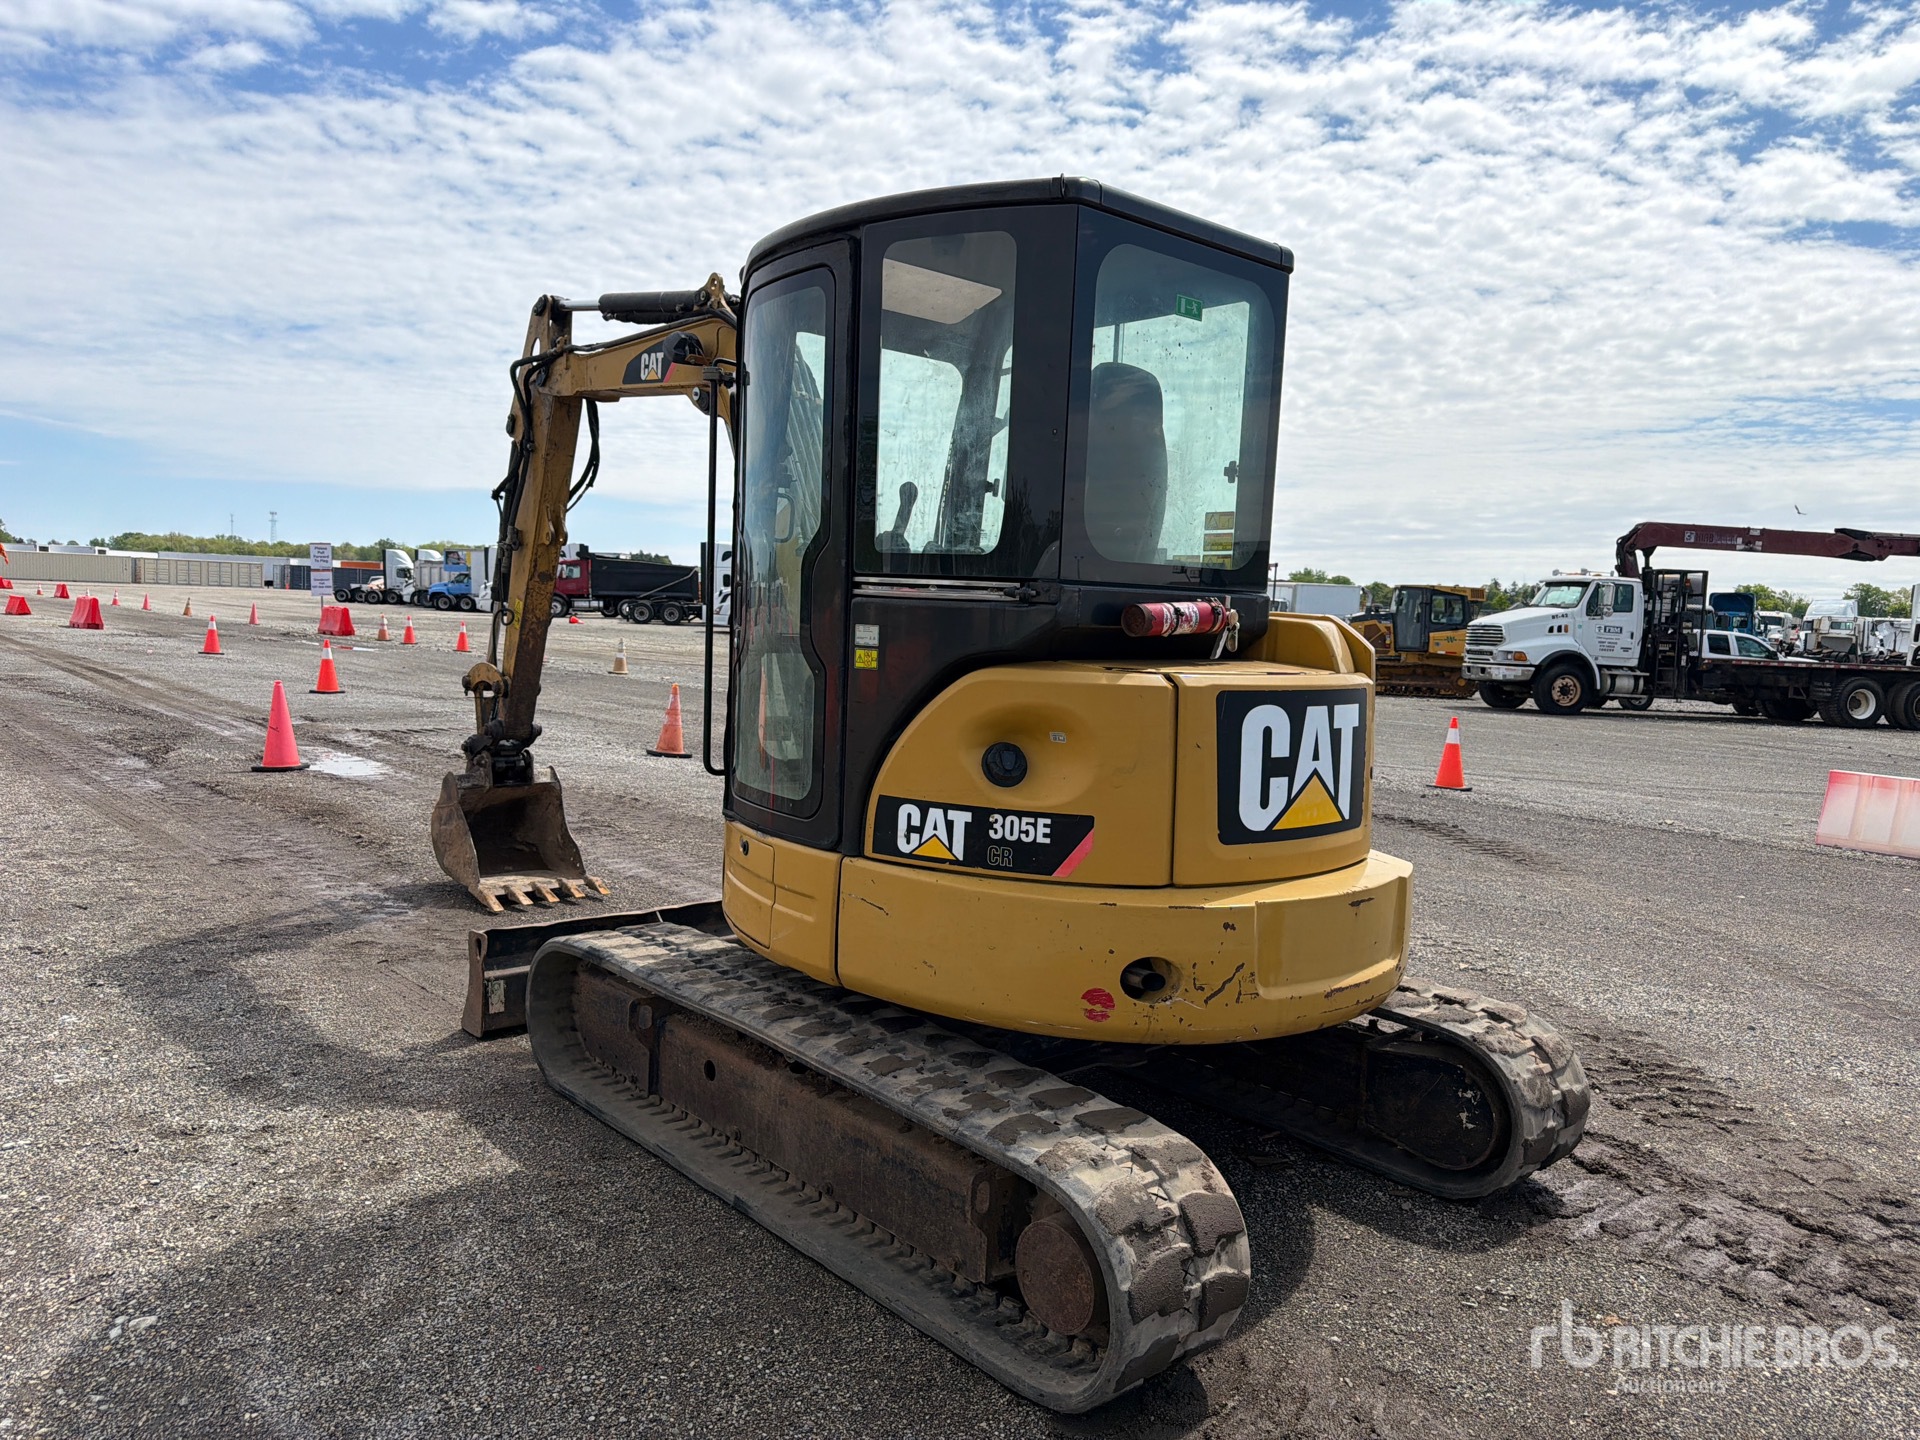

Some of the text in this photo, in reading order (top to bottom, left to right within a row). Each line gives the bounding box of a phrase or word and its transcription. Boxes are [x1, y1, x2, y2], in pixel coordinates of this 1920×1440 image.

[640, 352, 664, 380] CAT
[1238, 703, 1360, 832] CAT
[896, 803, 1052, 861] CAT 305E
[987, 845, 1013, 867] CR
